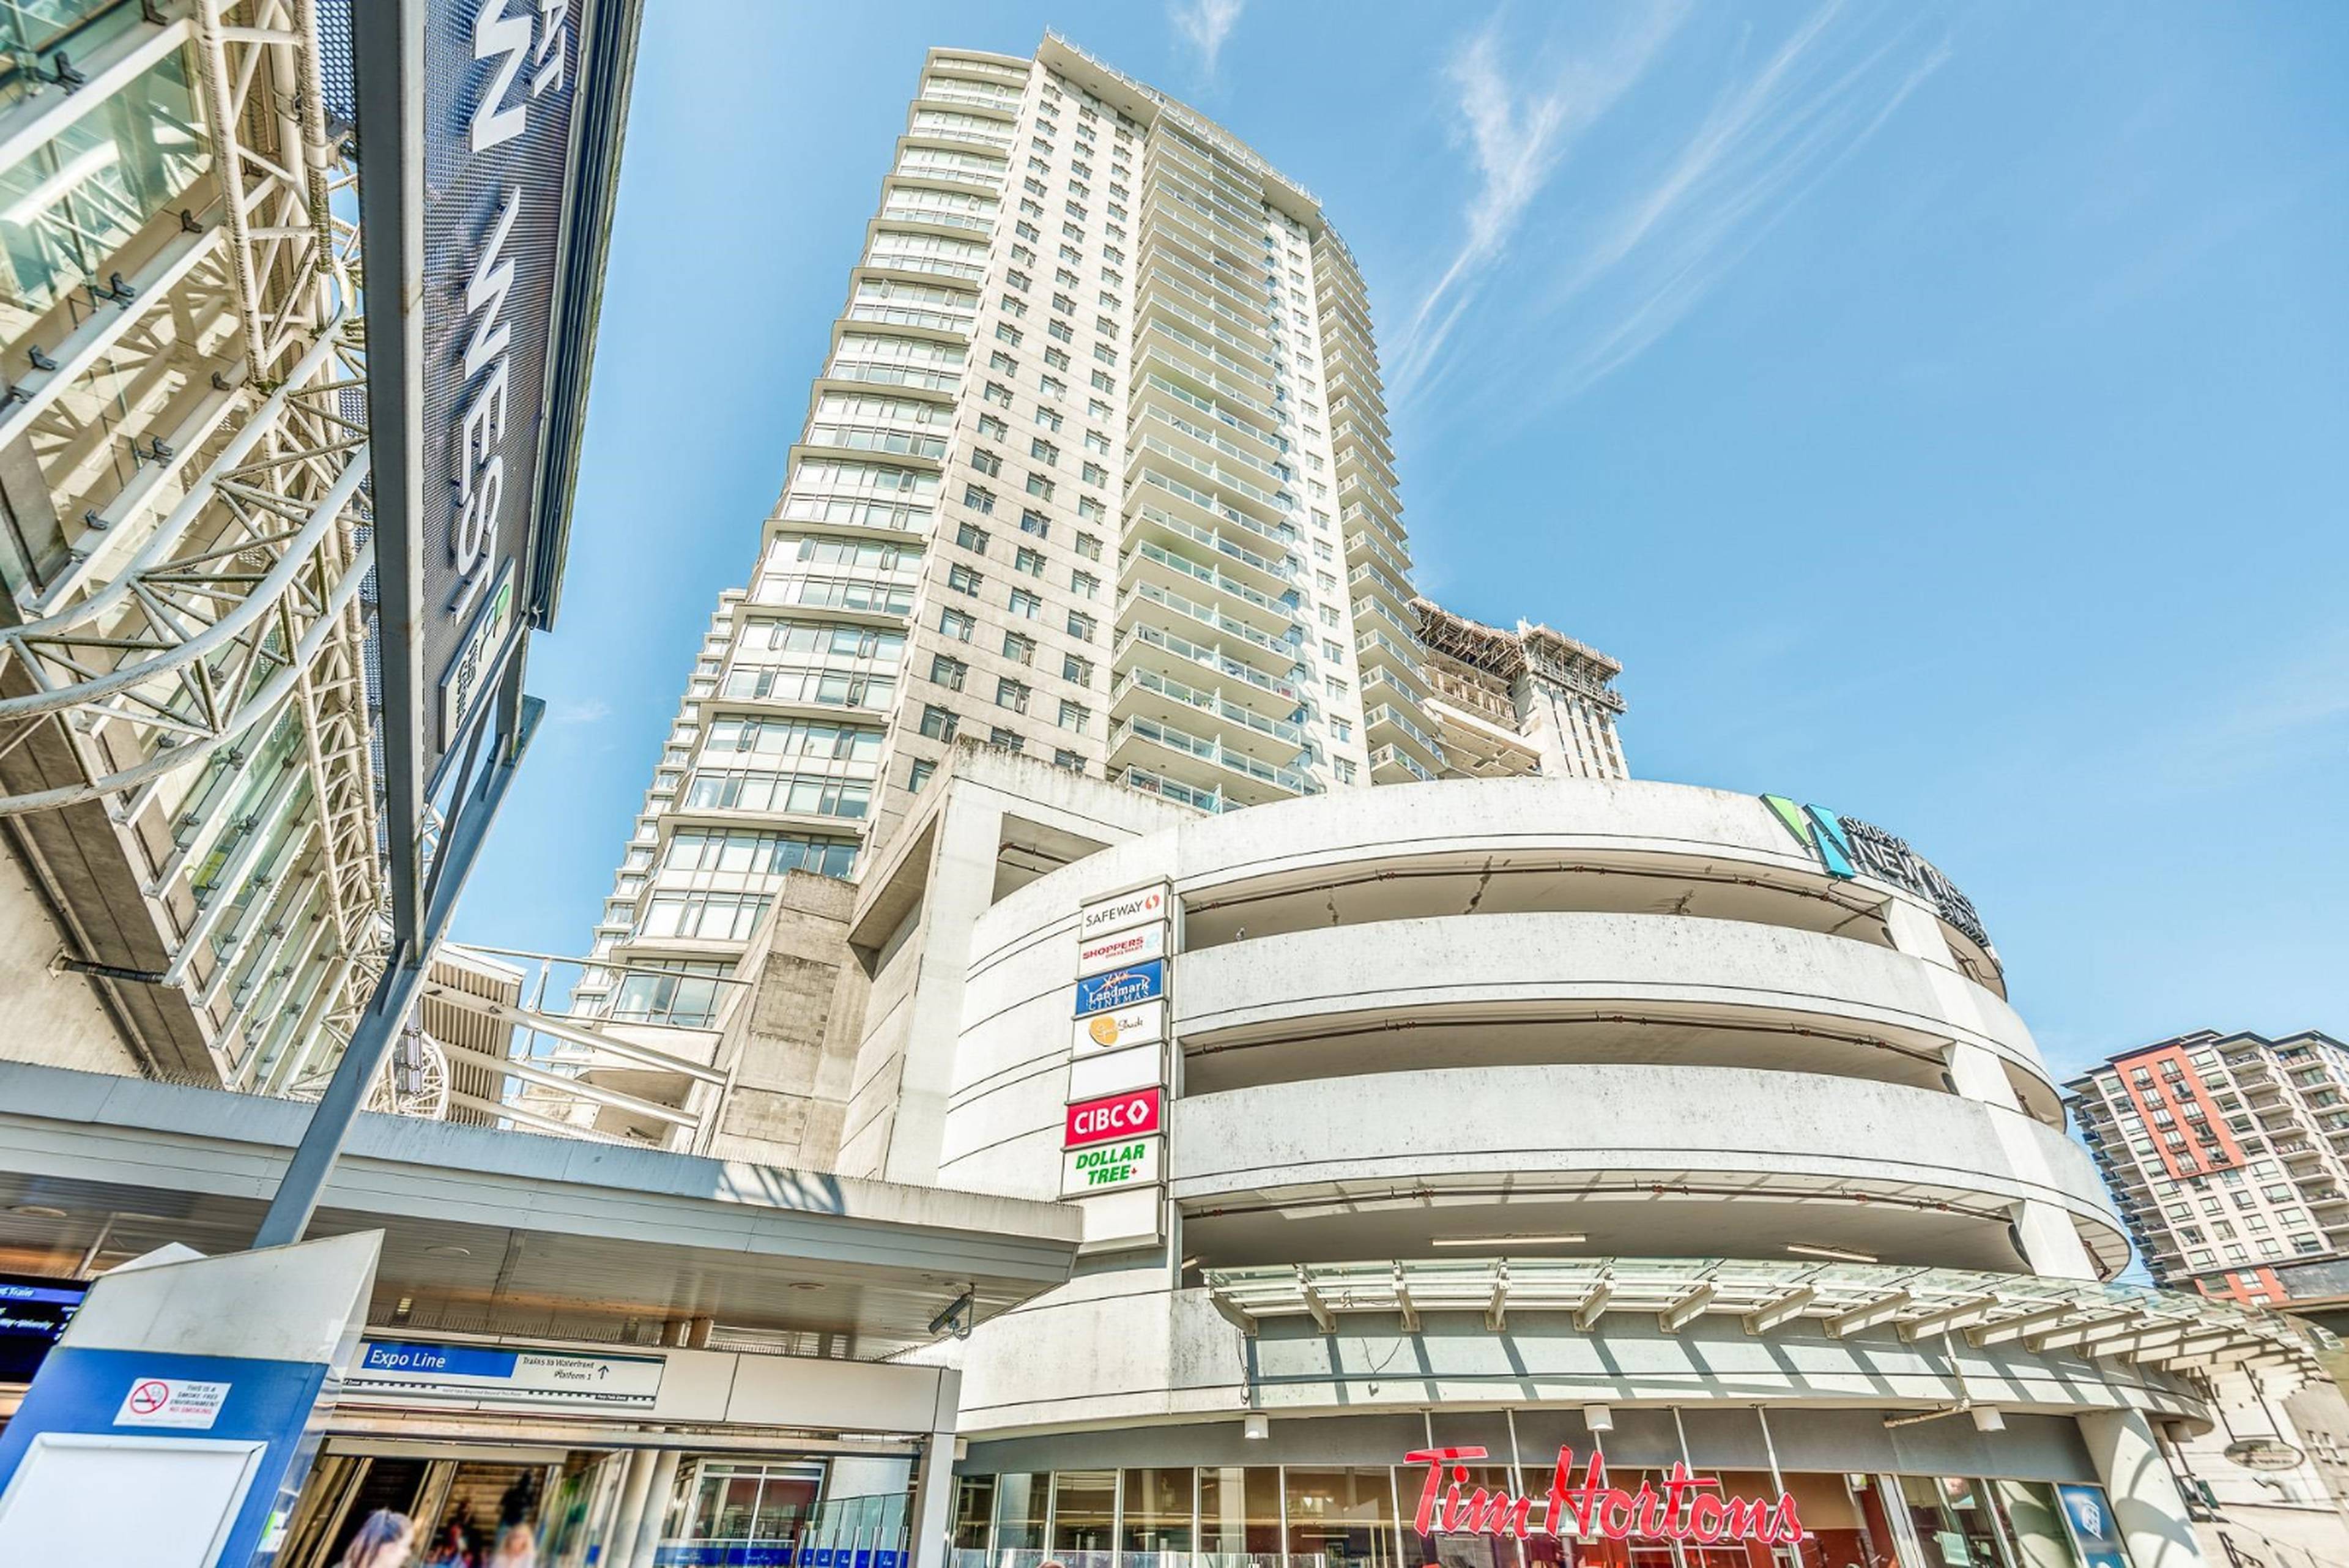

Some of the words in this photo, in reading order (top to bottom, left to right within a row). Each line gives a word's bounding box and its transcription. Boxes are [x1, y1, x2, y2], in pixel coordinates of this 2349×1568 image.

[455, 184, 521, 627] WEST
[1839, 815, 1897, 849] SHOPS
[1849, 833, 1926, 888] NEW
[1085, 899, 1143, 927] SAFEWAY
[1083, 936, 1144, 959] SHOPPERS
[1088, 978, 1150, 1003] Landmark
[1088, 990, 1150, 1011] CINEMAS
[1074, 1104, 1124, 1134] CIBC
[1075, 1143, 1145, 1170] DOLLAR
[1088, 1164, 1131, 1186] TREE
[370, 1350, 409, 1369] Expo
[412, 1353, 446, 1368] Line
[523, 1356, 545, 1366] Trains
[555, 1359, 595, 1369] Waterfront
[554, 1370, 585, 1380] Platform
[1403, 1446, 1531, 1540] Tim
[1544, 1444, 1804, 1544] Hortons
